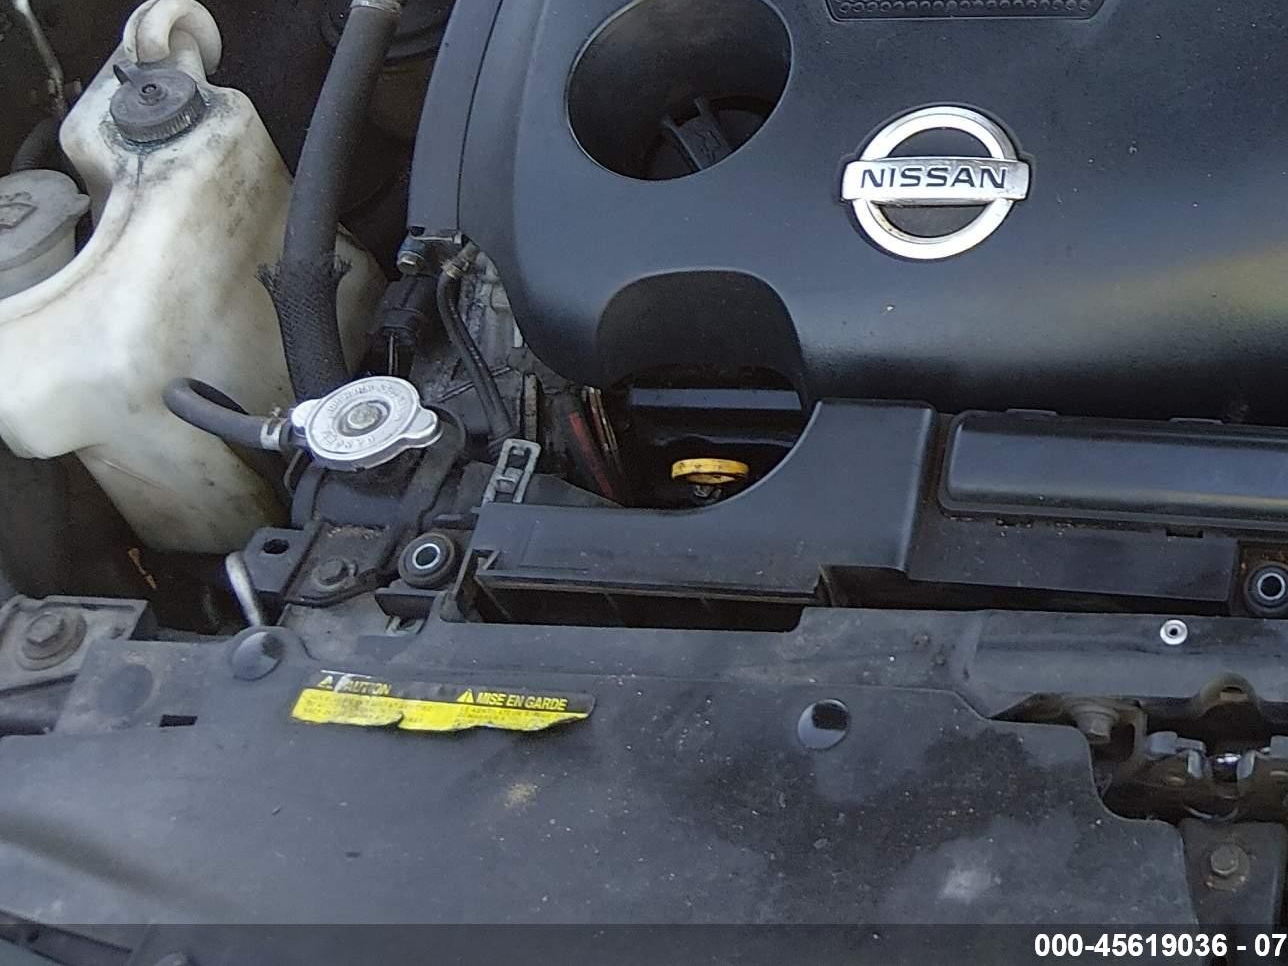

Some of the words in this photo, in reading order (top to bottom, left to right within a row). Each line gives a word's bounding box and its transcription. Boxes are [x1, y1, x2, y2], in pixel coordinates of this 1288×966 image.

[860, 167, 1008, 189] NISSAN
[476, 692, 507, 707] MISE
[506, 694, 525, 707] EN
[524, 695, 569, 711] GARDE
